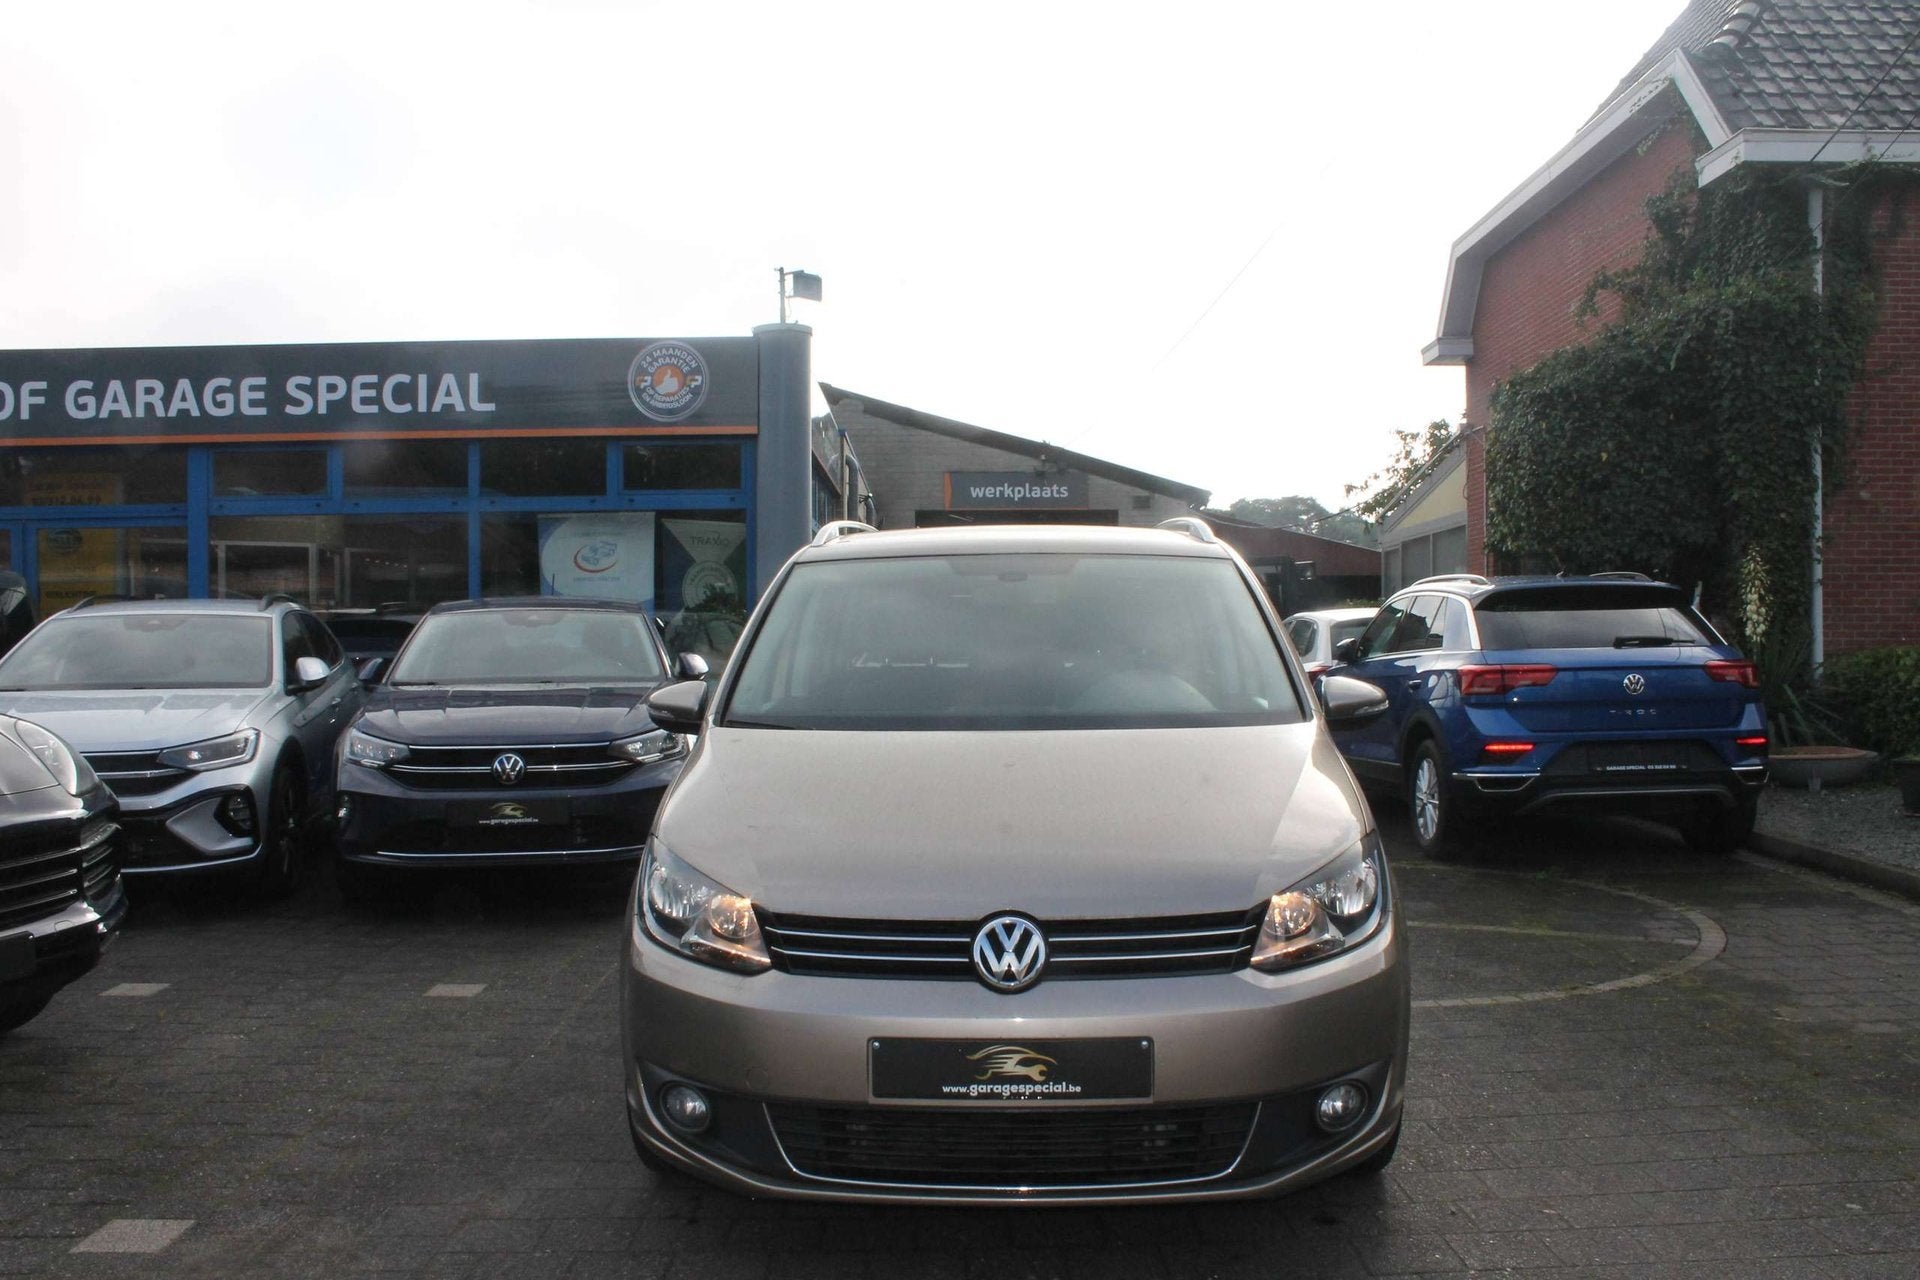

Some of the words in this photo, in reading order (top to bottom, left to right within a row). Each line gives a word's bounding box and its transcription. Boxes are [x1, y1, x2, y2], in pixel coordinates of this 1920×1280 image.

[652, 348, 698, 368] MAANDEN
[64, 377, 268, 420] GARAGE
[284, 373, 496, 416] SPECIAL
[970, 483, 1069, 501] werkplaats
[973, 916, 1046, 988] VW
[942, 1081, 1082, 1096] www.garagespecial.be
